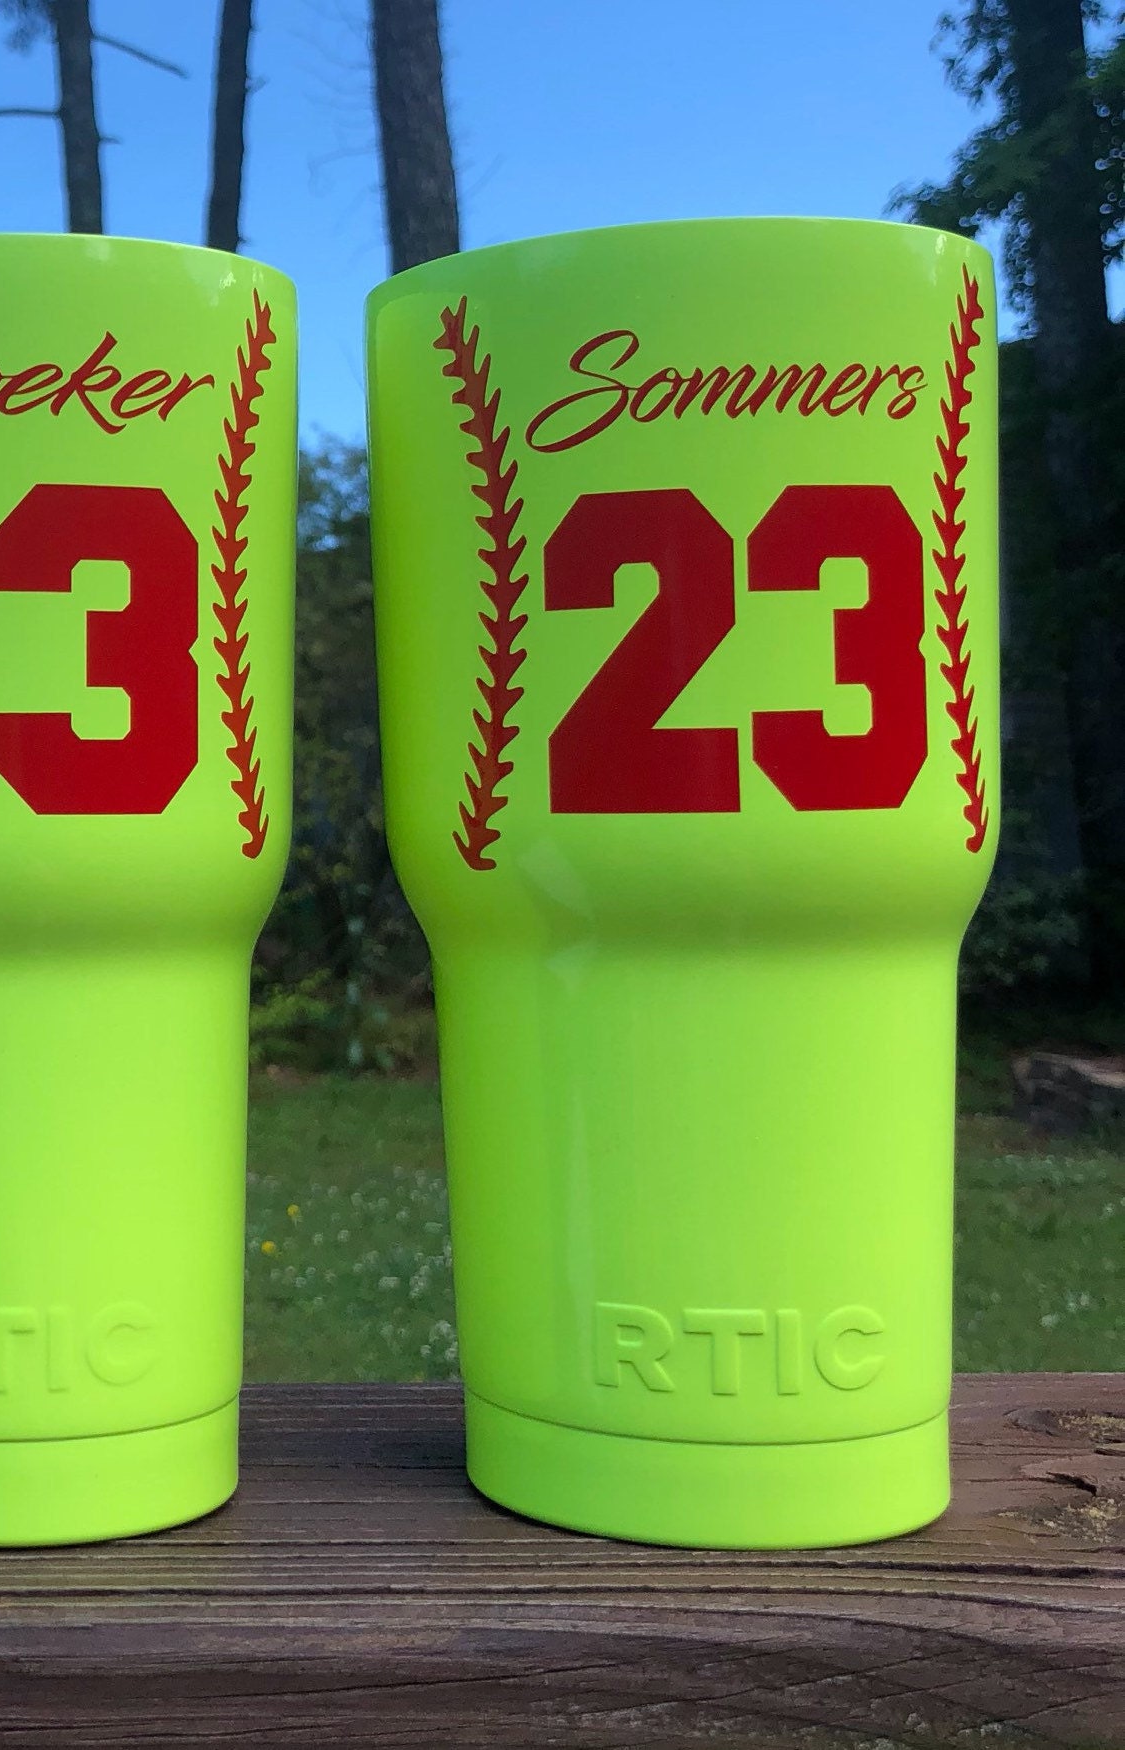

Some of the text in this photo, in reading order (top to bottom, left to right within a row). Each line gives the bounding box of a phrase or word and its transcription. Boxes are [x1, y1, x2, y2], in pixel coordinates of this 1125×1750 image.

[525, 329, 928, 454] Sommers
[543, 484, 928, 814] 23
[594, 1301, 886, 1397] RTIC
